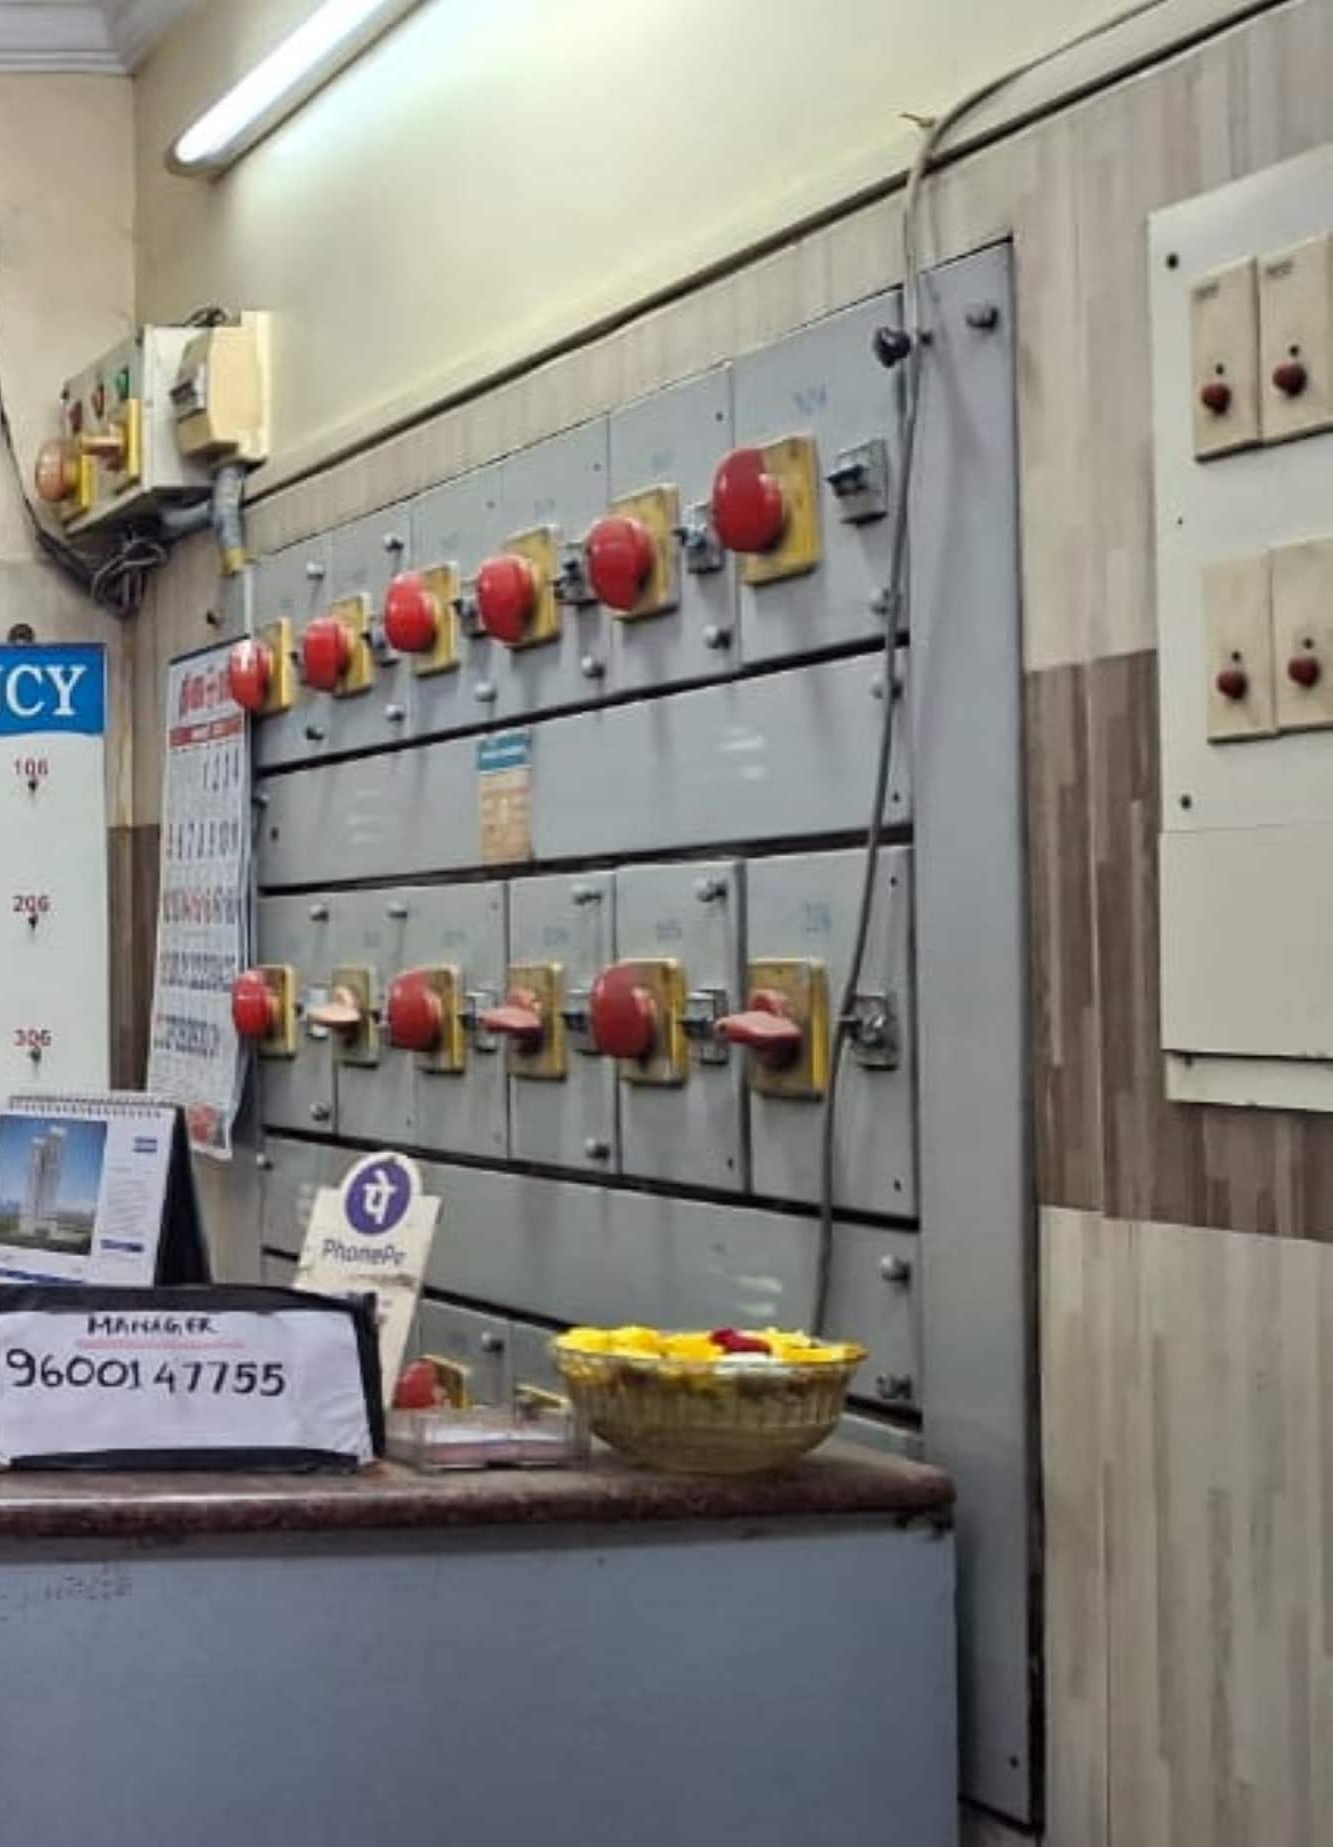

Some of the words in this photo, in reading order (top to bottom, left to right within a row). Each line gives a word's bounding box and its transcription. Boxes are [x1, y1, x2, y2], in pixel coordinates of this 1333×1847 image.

[13, 895, 50, 912] 206
[14, 1030, 52, 1046] 306
[322, 1238, 407, 1266] PhonePe
[87, 1316, 219, 1336] MANAGER
